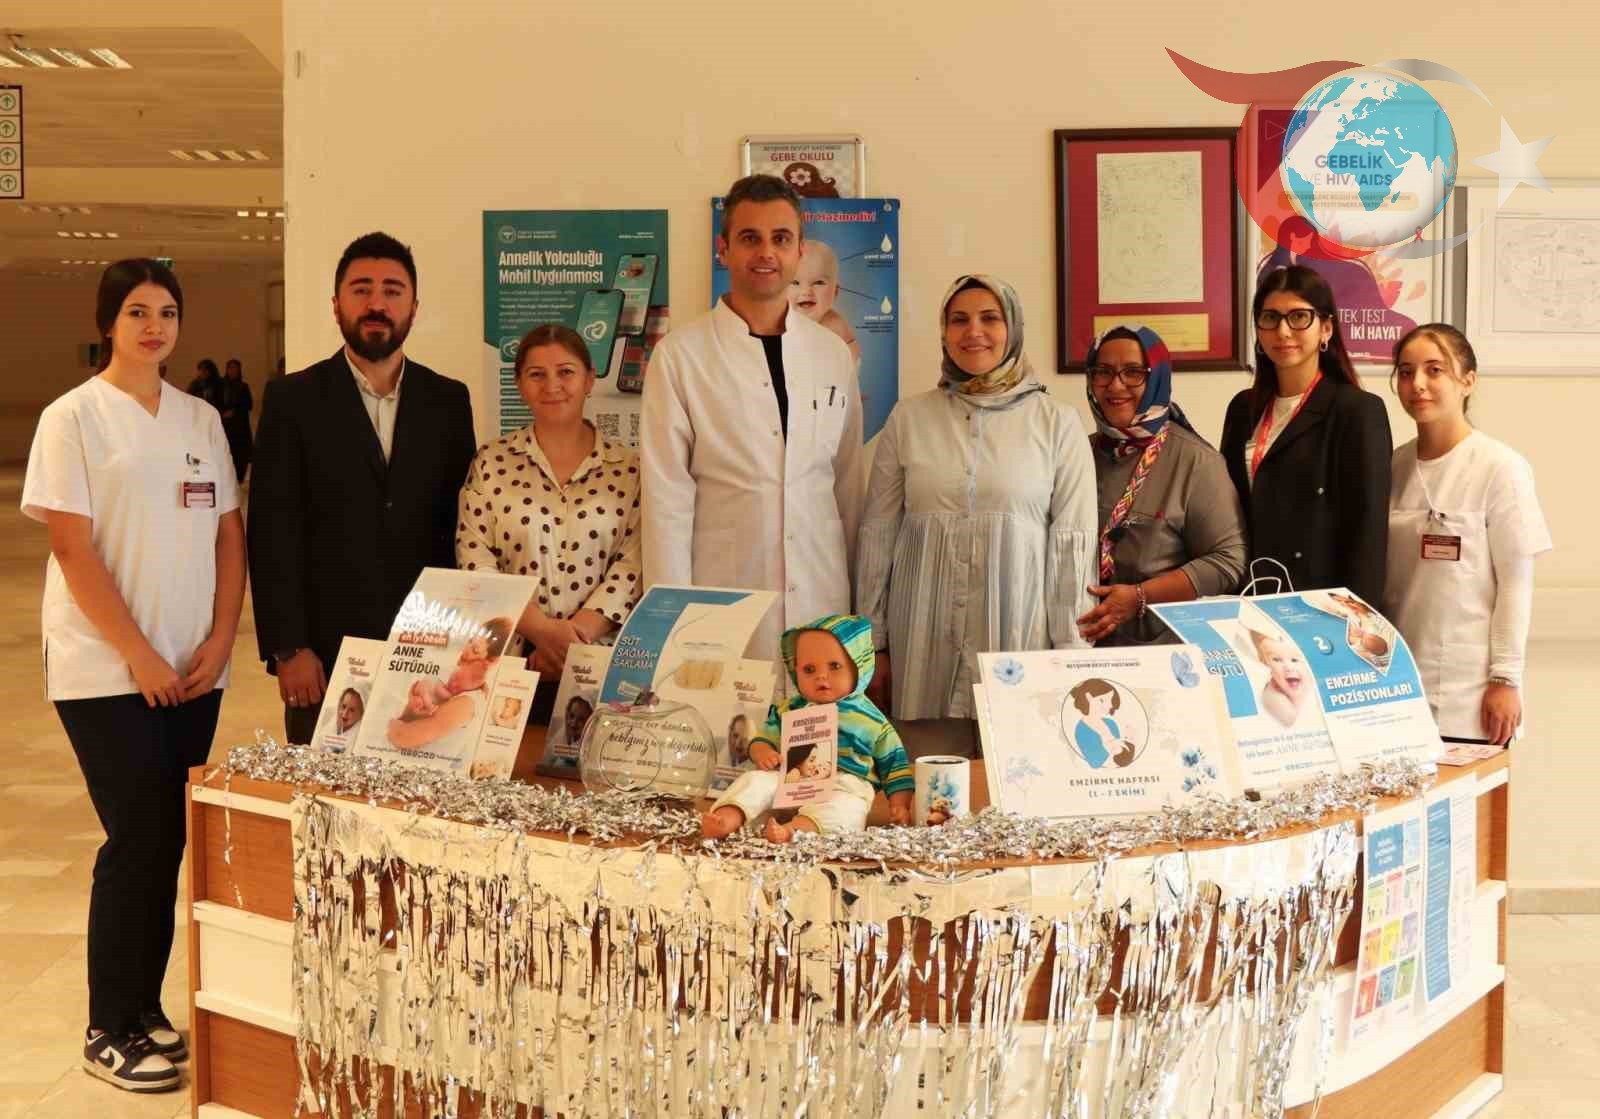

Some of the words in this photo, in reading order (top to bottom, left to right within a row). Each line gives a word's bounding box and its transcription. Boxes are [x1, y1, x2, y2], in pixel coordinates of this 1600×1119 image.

[770, 152, 797, 161] GEBE
[800, 151, 834, 161] OKULU
[1314, 152, 1383, 169] GEBELİK
[499, 250, 544, 266] Annelik
[544, 249, 603, 267] Yolculuğu
[499, 269, 531, 284] Mobil
[533, 269, 603, 286] Uygulaması
[1338, 308, 1358, 323] TEK
[1360, 308, 1386, 323] TEST
[1351, 323, 1365, 340] İKİ
[1367, 325, 1402, 340] HAYAT
[392, 645, 425, 658] ANNE
[1312, 636, 1329, 652] 2
[388, 658, 440, 676] SÜTÜDÜR
[1326, 671, 1378, 690] EMZİRME
[1330, 682, 1413, 707] POZİSYONLARI
[1069, 776, 1114, 787] EMZİRME
[1118, 775, 1160, 785] HAFTASI
